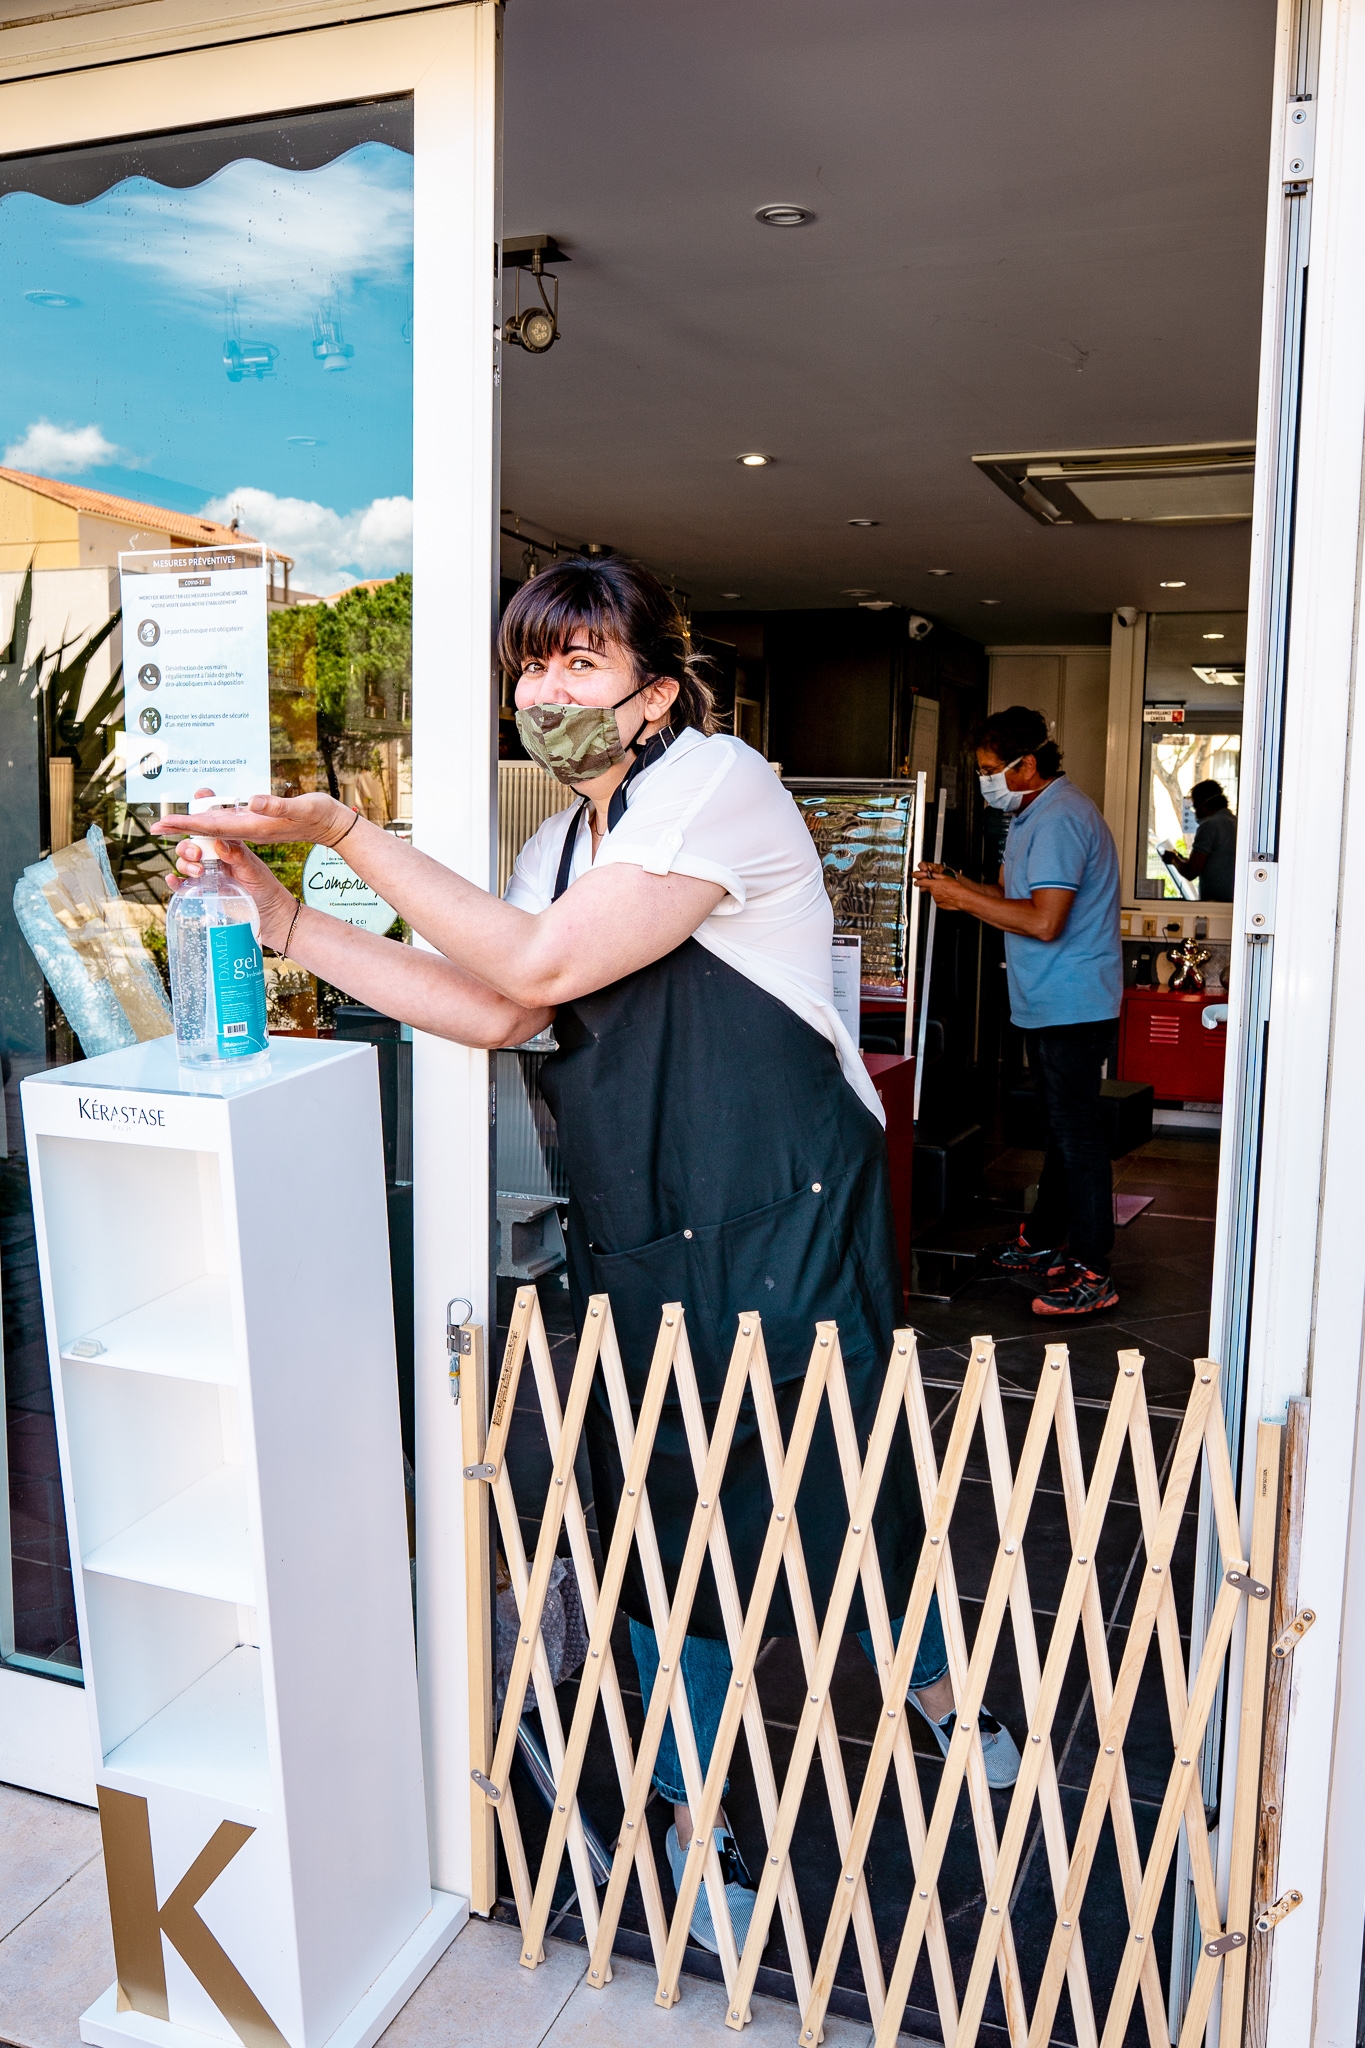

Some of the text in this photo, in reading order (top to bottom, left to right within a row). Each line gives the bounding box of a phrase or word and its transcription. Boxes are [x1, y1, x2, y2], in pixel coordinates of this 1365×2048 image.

[153, 555, 236, 568] MESURES PRÉVENTIVES
[214, 930, 229, 981] DAMÉA
[233, 948, 257, 979] gel
[78, 1098, 166, 1126] KÉRASTASE
[96, 1784, 292, 2048] K
